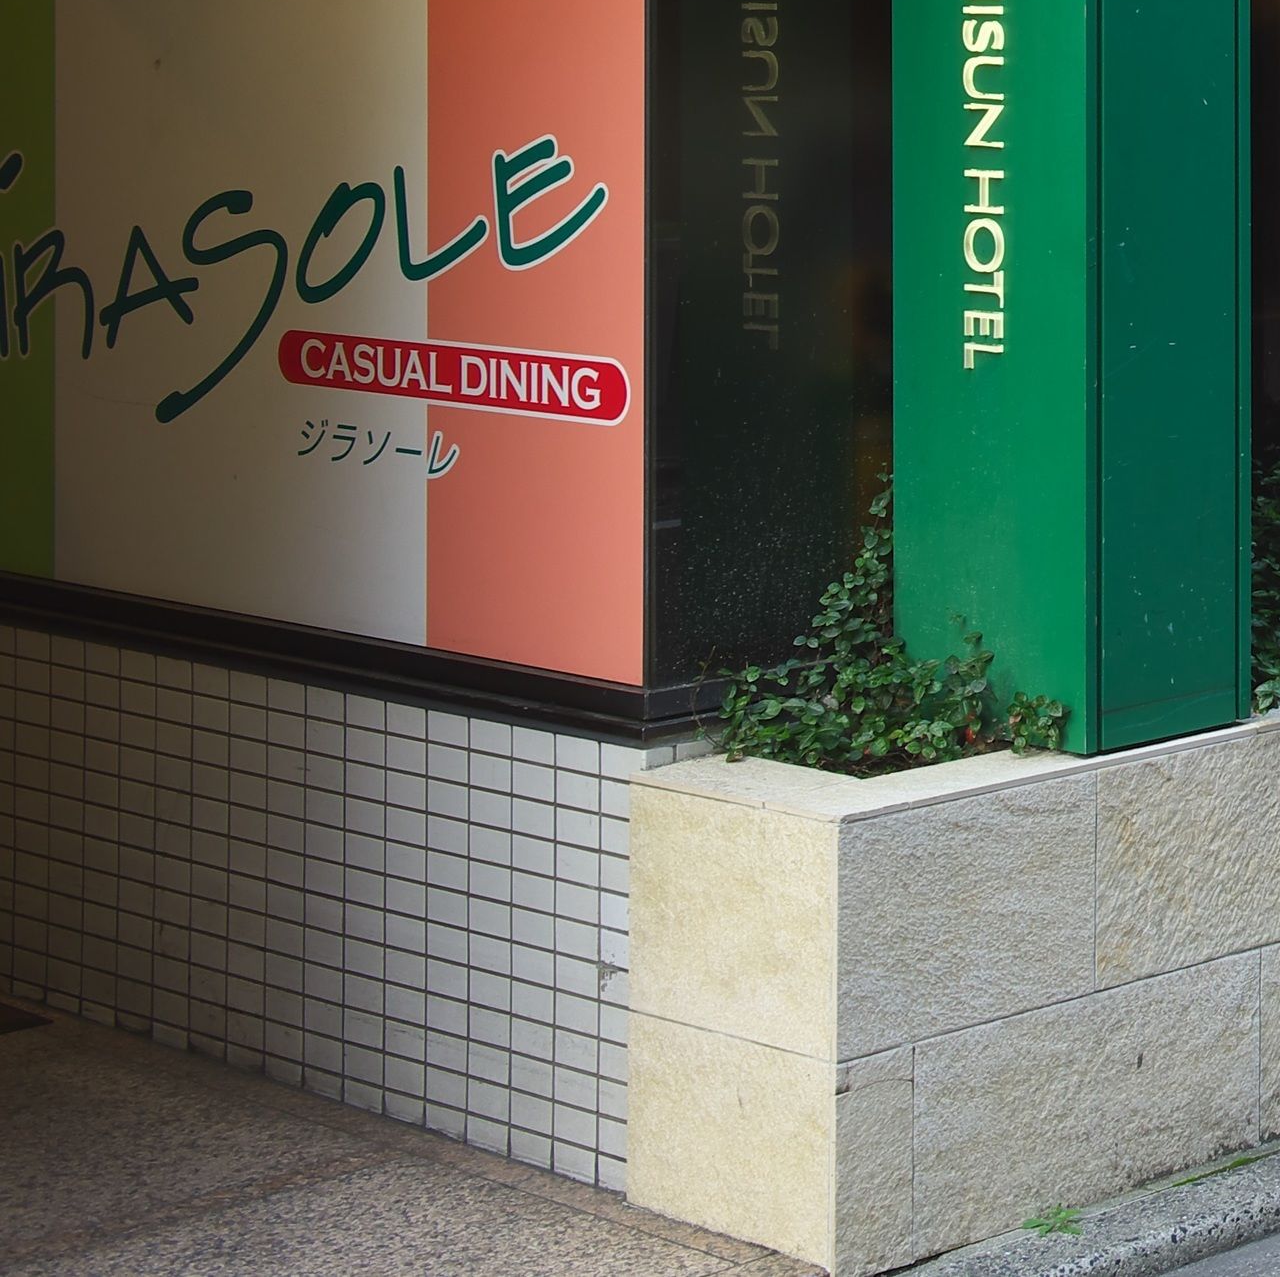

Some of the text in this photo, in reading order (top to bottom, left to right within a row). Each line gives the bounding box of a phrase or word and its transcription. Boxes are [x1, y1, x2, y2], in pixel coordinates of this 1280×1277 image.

[963, 168, 1006, 370] HOTEL
[300, 338, 602, 411] CASUAL DINING
[297, 419, 459, 476] ジラソーレ
